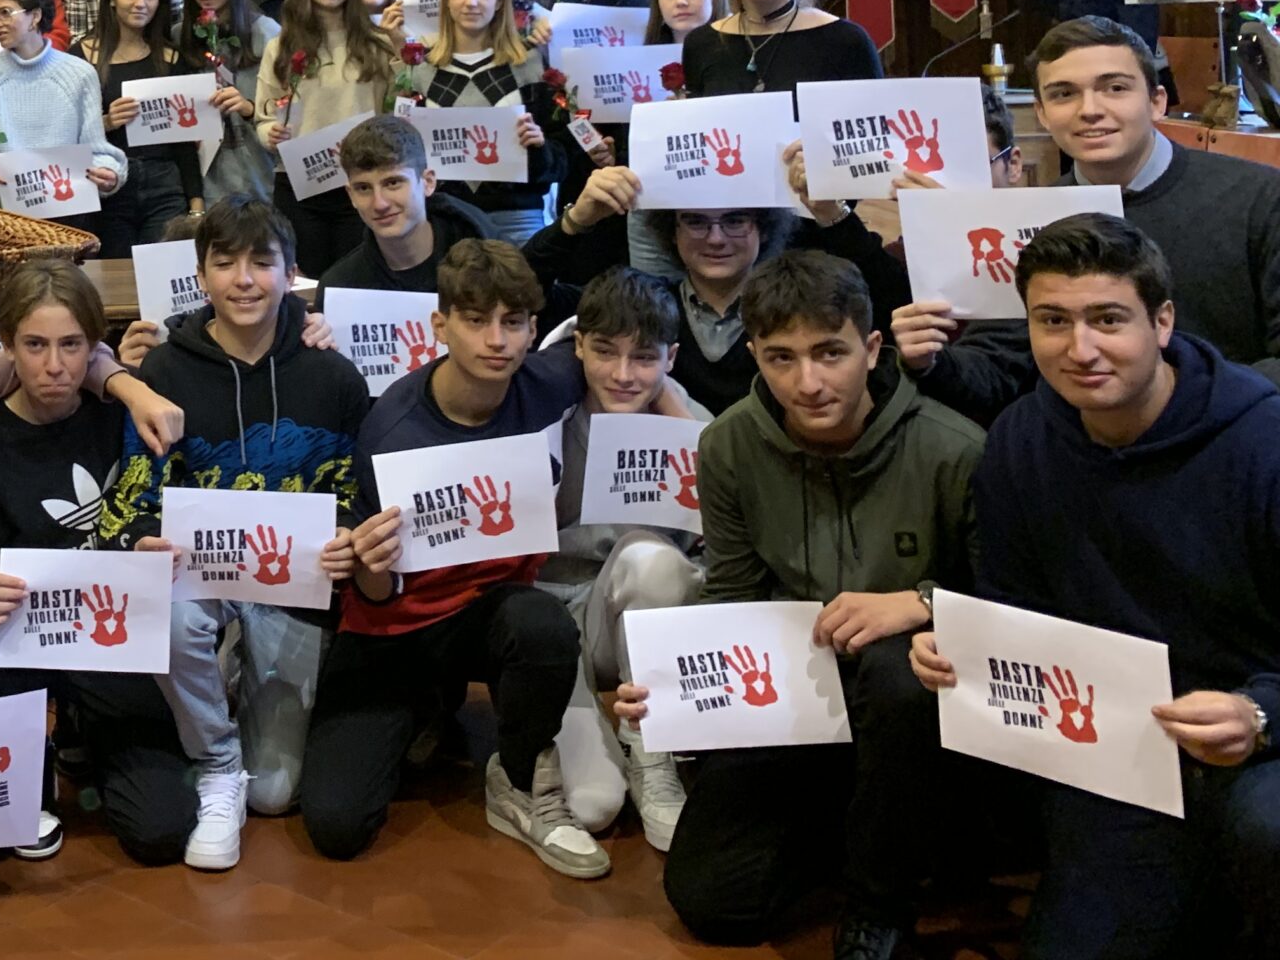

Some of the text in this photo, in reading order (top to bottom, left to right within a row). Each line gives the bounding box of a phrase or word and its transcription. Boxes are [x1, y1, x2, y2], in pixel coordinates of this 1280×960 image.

[432, 127, 468, 141] BASTA
[833, 115, 890, 141] BASTA
[667, 132, 706, 151] BASTA
[833, 136, 890, 159] VIOLENZA
[665, 148, 706, 164] VIOLENZA
[14, 169, 45, 186] BASTA
[677, 166, 706, 180] DONNE
[849, 160, 890, 178] DONNE
[171, 275, 199, 294] BAST
[352, 324, 398, 343] BASTA
[350, 343, 397, 358] VIOLENZA
[362, 364, 396, 377] DONNE
[617, 449, 669, 469] BASTA
[614, 469, 666, 485] VIOLENZA
[413, 483, 467, 514] BASTA
[624, 490, 661, 504] DONNE
[413, 506, 467, 529] VIOLENZA
[194, 529, 247, 550] BASTA
[427, 527, 466, 547] DONNE
[191, 550, 244, 565] VIOLENZA
[202, 570, 240, 581] DONNE
[30, 588, 83, 609] BASTA
[27, 608, 80, 625] VIOLENZA
[39, 630, 78, 647] DONNE
[677, 651, 729, 677] BASTA
[988, 657, 1046, 689] BASTA
[680, 671, 729, 693] VIOLENZA
[989, 682, 1045, 705] VIOLENZA
[695, 694, 732, 713] DONNE
[1003, 710, 1044, 730] DONNE
